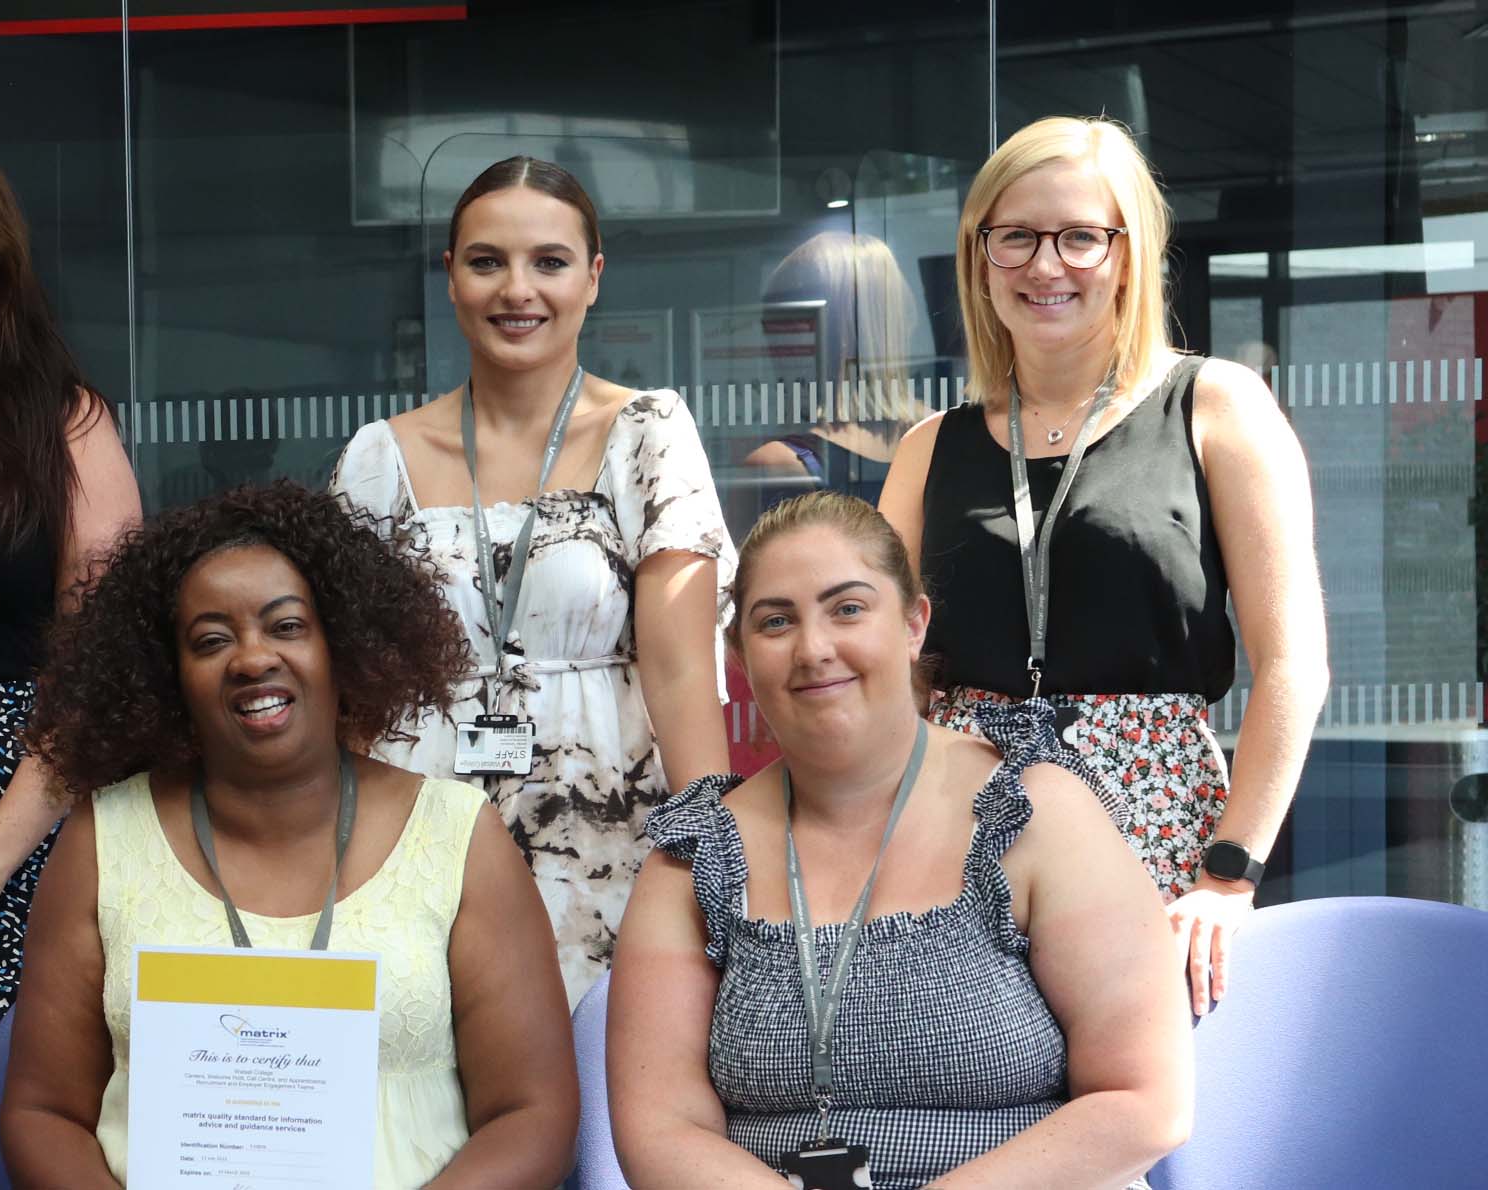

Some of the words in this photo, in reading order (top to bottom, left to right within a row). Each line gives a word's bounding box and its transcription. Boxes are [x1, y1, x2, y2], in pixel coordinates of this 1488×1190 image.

[495, 750, 527, 759] STAFF
[240, 1027, 287, 1039] matrix
[189, 1049, 219, 1063] This
[223, 1052, 233, 1064] is
[235, 1055, 249, 1064] to
[252, 1053, 292, 1070] certify
[295, 1054, 321, 1068] that
[208, 1113, 232, 1121] quality
[234, 1114, 266, 1122] standard
[280, 1116, 323, 1125] information
[239, 1123, 273, 1131] guidance
